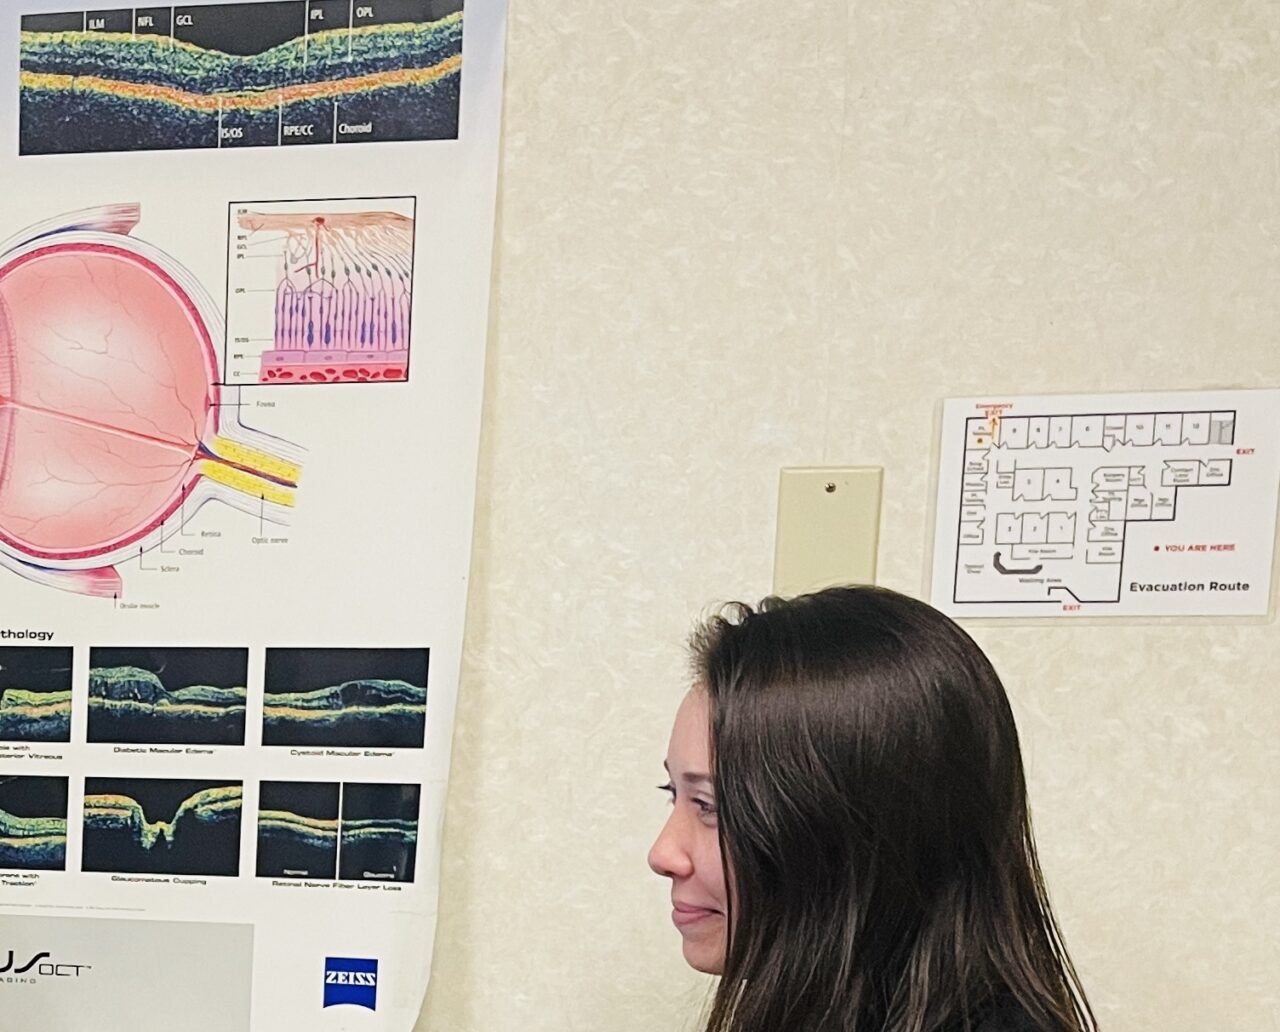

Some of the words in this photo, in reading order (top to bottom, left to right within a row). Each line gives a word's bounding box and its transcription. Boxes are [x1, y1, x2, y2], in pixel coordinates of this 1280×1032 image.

[311, 9, 323, 20] IPL
[357, 7, 373, 17] OPL
[89, 19, 104, 32] ILM
[138, 16, 153, 27] NFL
[176, 15, 193, 25] GCL
[221, 126, 243, 140] IS/OS
[284, 125, 313, 136] RPE/CC
[339, 122, 372, 134] Choroid
[1130, 582, 1204, 591] Evacuation
[1210, 582, 1249, 591] Route
[326, 971, 375, 986] ZEISS
